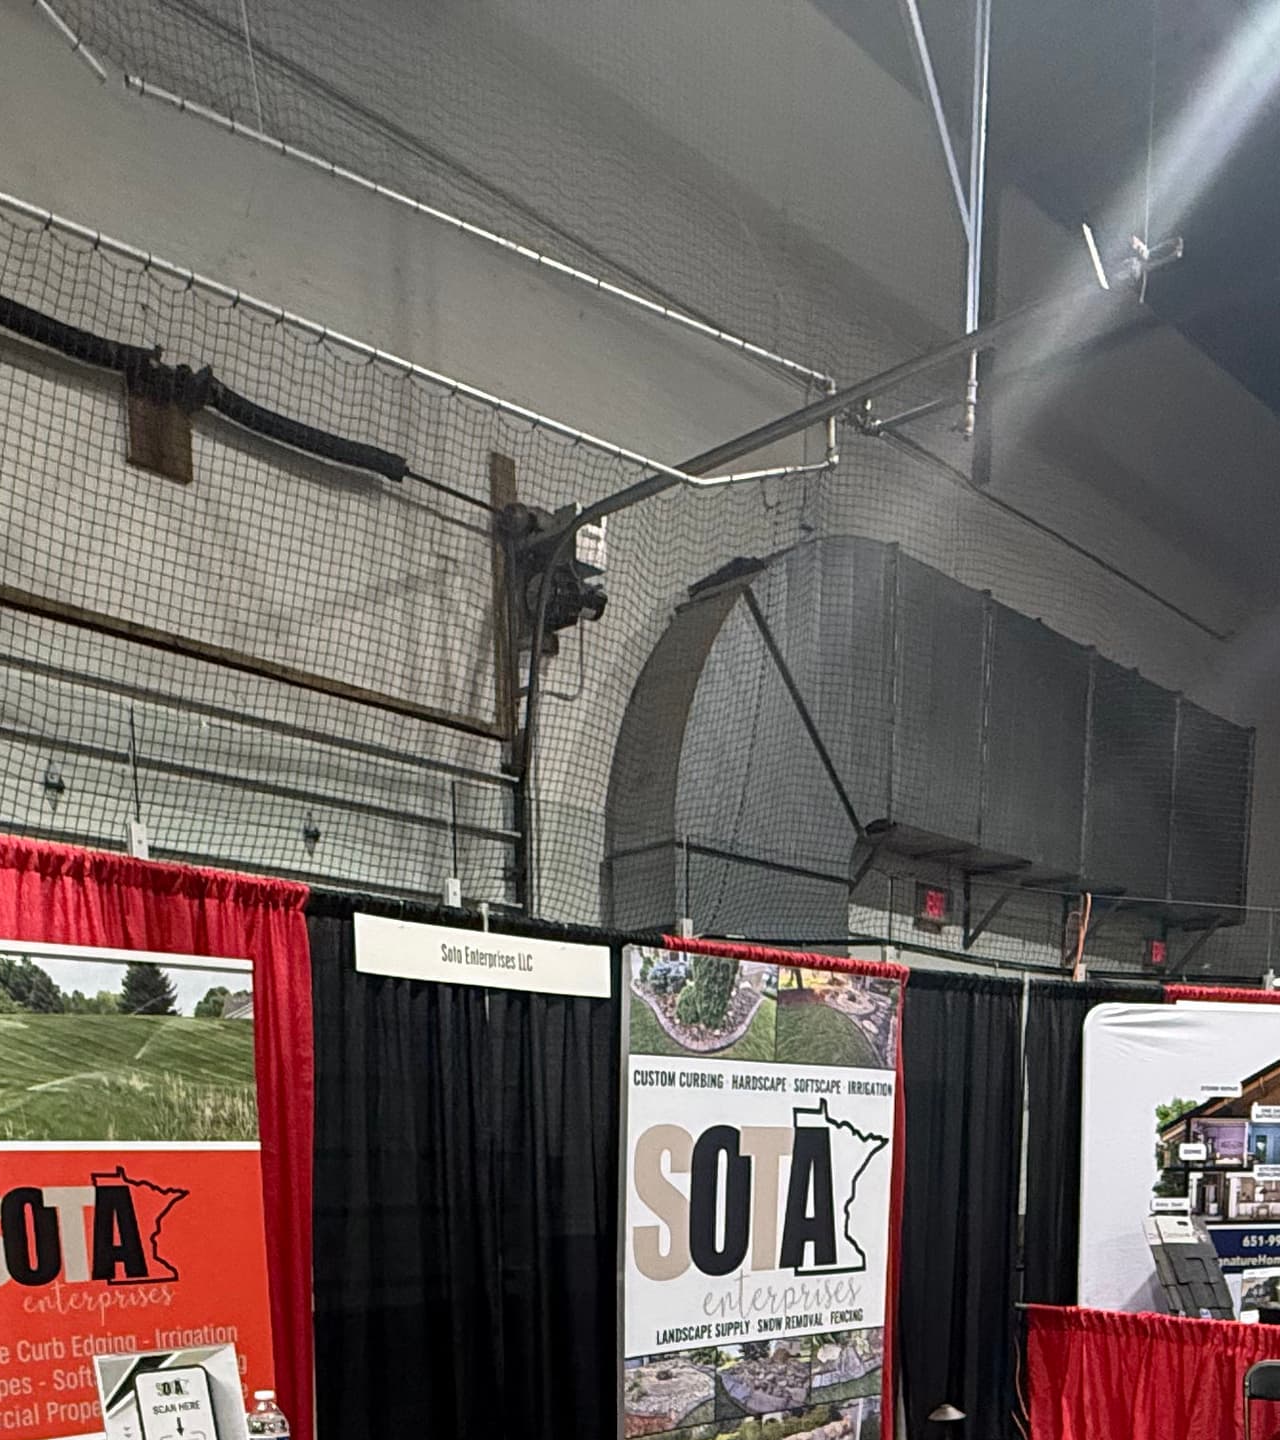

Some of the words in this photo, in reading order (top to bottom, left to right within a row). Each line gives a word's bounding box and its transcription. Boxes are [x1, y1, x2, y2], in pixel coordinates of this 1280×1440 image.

[465, 946, 516, 969] Enterprises
[518, 952, 533, 972] LLC
[633, 1069, 676, 1088] CUSTOM
[678, 1071, 724, 1090] CURBING
[731, 1073, 787, 1093] HARDSCAPE
[793, 1078, 842, 1095] SOFTSCAPE
[848, 1080, 893, 1097] IRRIGATION
[632, 1124, 840, 1282] SOTA
[23, 1281, 176, 1326] enterprises
[702, 1268, 863, 1333] enterprises
[16, 1335, 65, 1362] Curb
[71, 1329, 136, 1356] Edging
[155, 1323, 238, 1349] Irrigation
[656, 1324, 713, 1345] LANDSCAPE
[715, 1320, 751, 1338] SUPPLY
[757, 1316, 783, 1333] SNOW
[785, 1312, 824, 1331] REMOVAL
[830, 1308, 864, 1325] FENCING
[52, 1365, 96, 1391] Soft
[46, 1400, 102, 1425] Prope
[152, 1404, 177, 1416] SCAN
[178, 1400, 201, 1412] HERE
